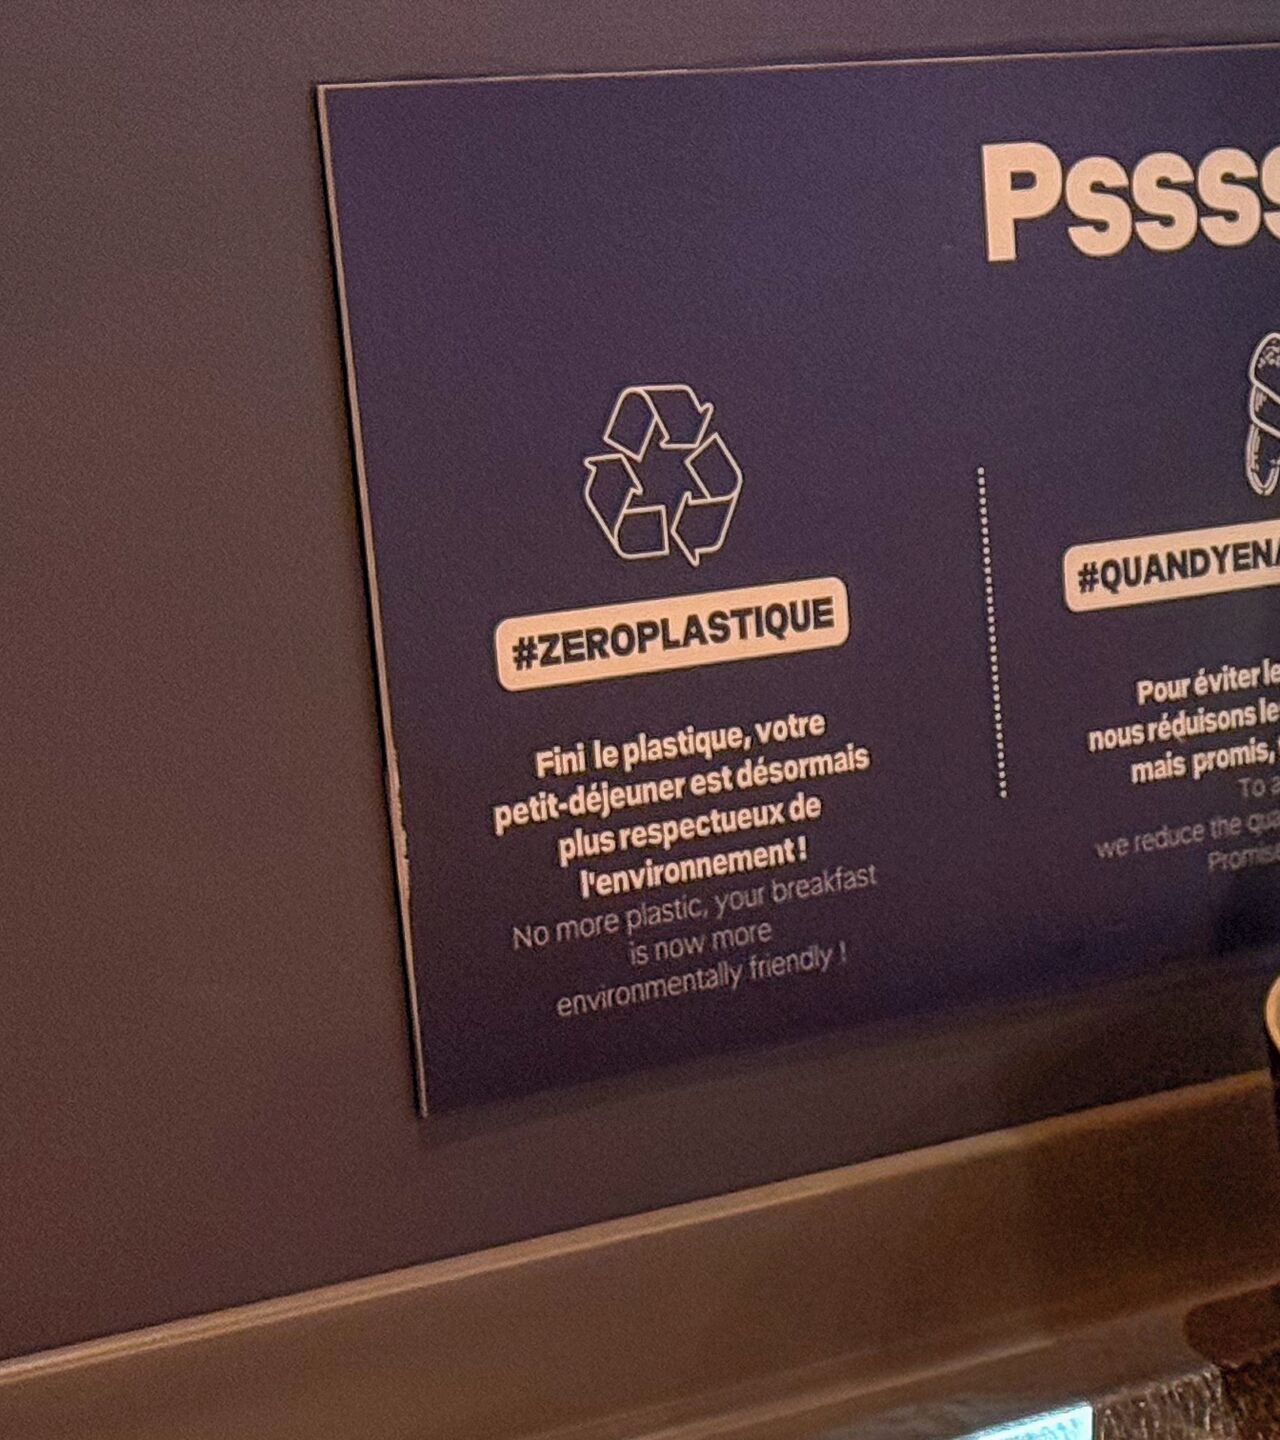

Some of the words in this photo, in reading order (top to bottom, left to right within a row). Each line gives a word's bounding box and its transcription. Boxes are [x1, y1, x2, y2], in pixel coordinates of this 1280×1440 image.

[512, 595, 835, 671] #ZEROPLASTIQUE
[1136, 677, 1191, 706] Pour
[1194, 664, 1261, 696] éviter
[535, 744, 586, 779] Fini
[594, 739, 619, 770] le
[623, 724, 752, 773] plastique,
[754, 712, 826, 745] votre
[1088, 722, 1145, 752] nous
[1148, 704, 1257, 743] réduisons
[493, 775, 687, 836] petit-déjeuner
[690, 767, 731, 796] est
[736, 742, 871, 790] désormais
[1131, 751, 1187, 784] mais
[1192, 737, 1276, 780] promis,
[558, 827, 616, 868] plus
[620, 805, 786, 851] respectueux
[789, 792, 823, 822] de
[1095, 836, 1129, 859] we
[1135, 821, 1205, 853] reduce
[1210, 815, 1242, 839] the
[580, 840, 796, 900] l'environnement
[512, 927, 550, 951] No
[556, 912, 619, 943] more
[626, 894, 709, 935] plastic,
[713, 886, 767, 918] your
[772, 863, 878, 903] breakfast
[630, 941, 649, 967] is
[655, 936, 704, 963] now
[712, 921, 773, 950] more
[556, 962, 745, 1019] environmentally
[750, 943, 834, 981] friendly
